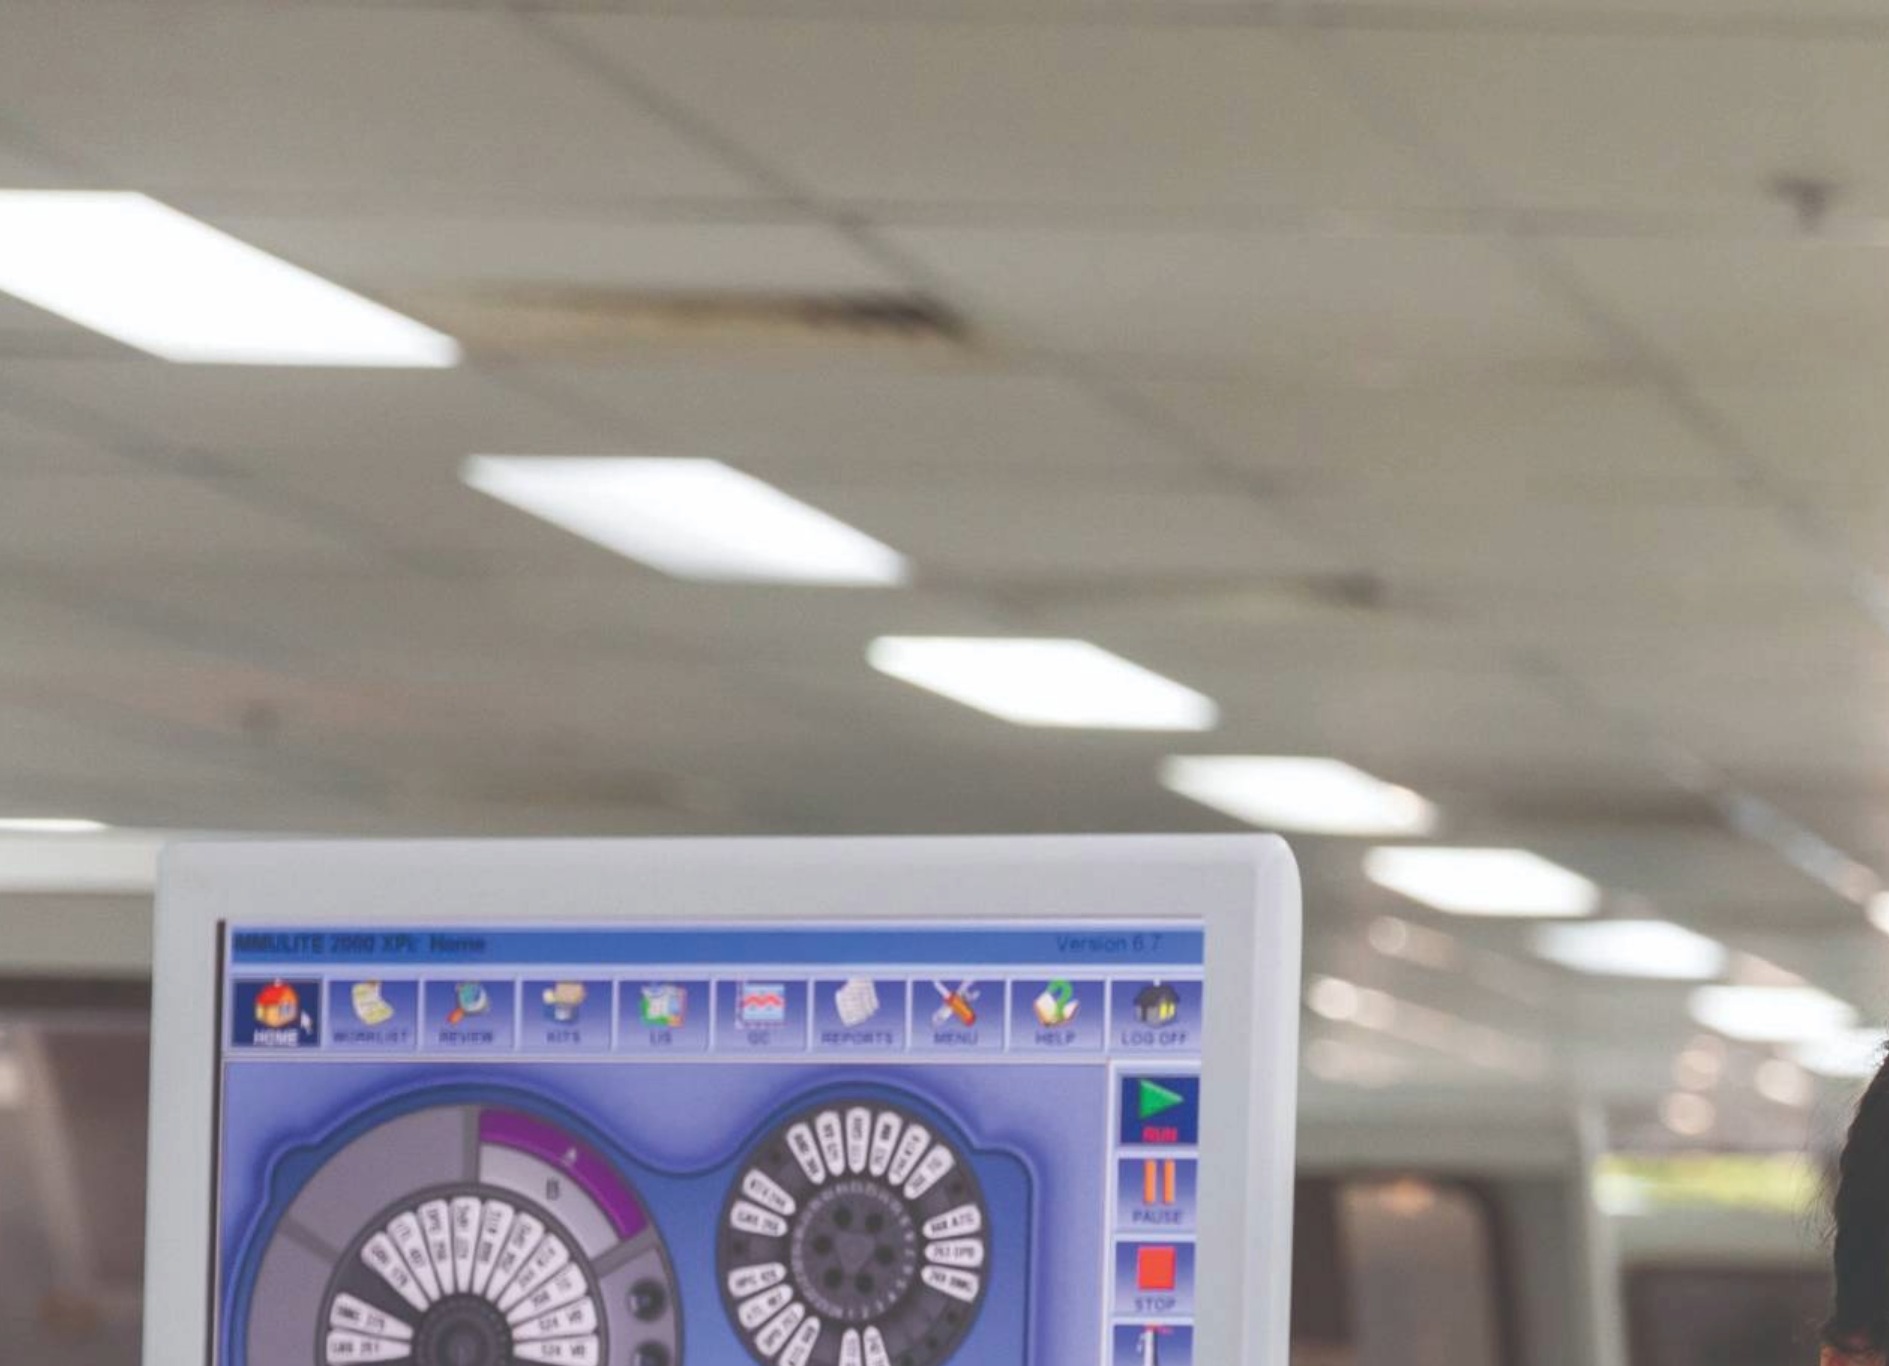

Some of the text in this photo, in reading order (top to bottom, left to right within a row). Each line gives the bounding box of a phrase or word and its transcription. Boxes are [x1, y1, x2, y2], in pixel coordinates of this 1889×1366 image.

[1056, 936, 1127, 953] Version
[253, 1030, 298, 1045] HOME
[438, 1031, 494, 1044] REVIEW
[822, 1032, 893, 1045] REPORTS
[933, 1032, 978, 1045] MENU
[1035, 1032, 1074, 1045] HELP
[1121, 1032, 1187, 1045] LOG OFF
[1142, 1126, 1177, 1142] RUN
[1132, 1210, 1183, 1225] PAUSE
[1135, 1298, 1176, 1312] STOP
